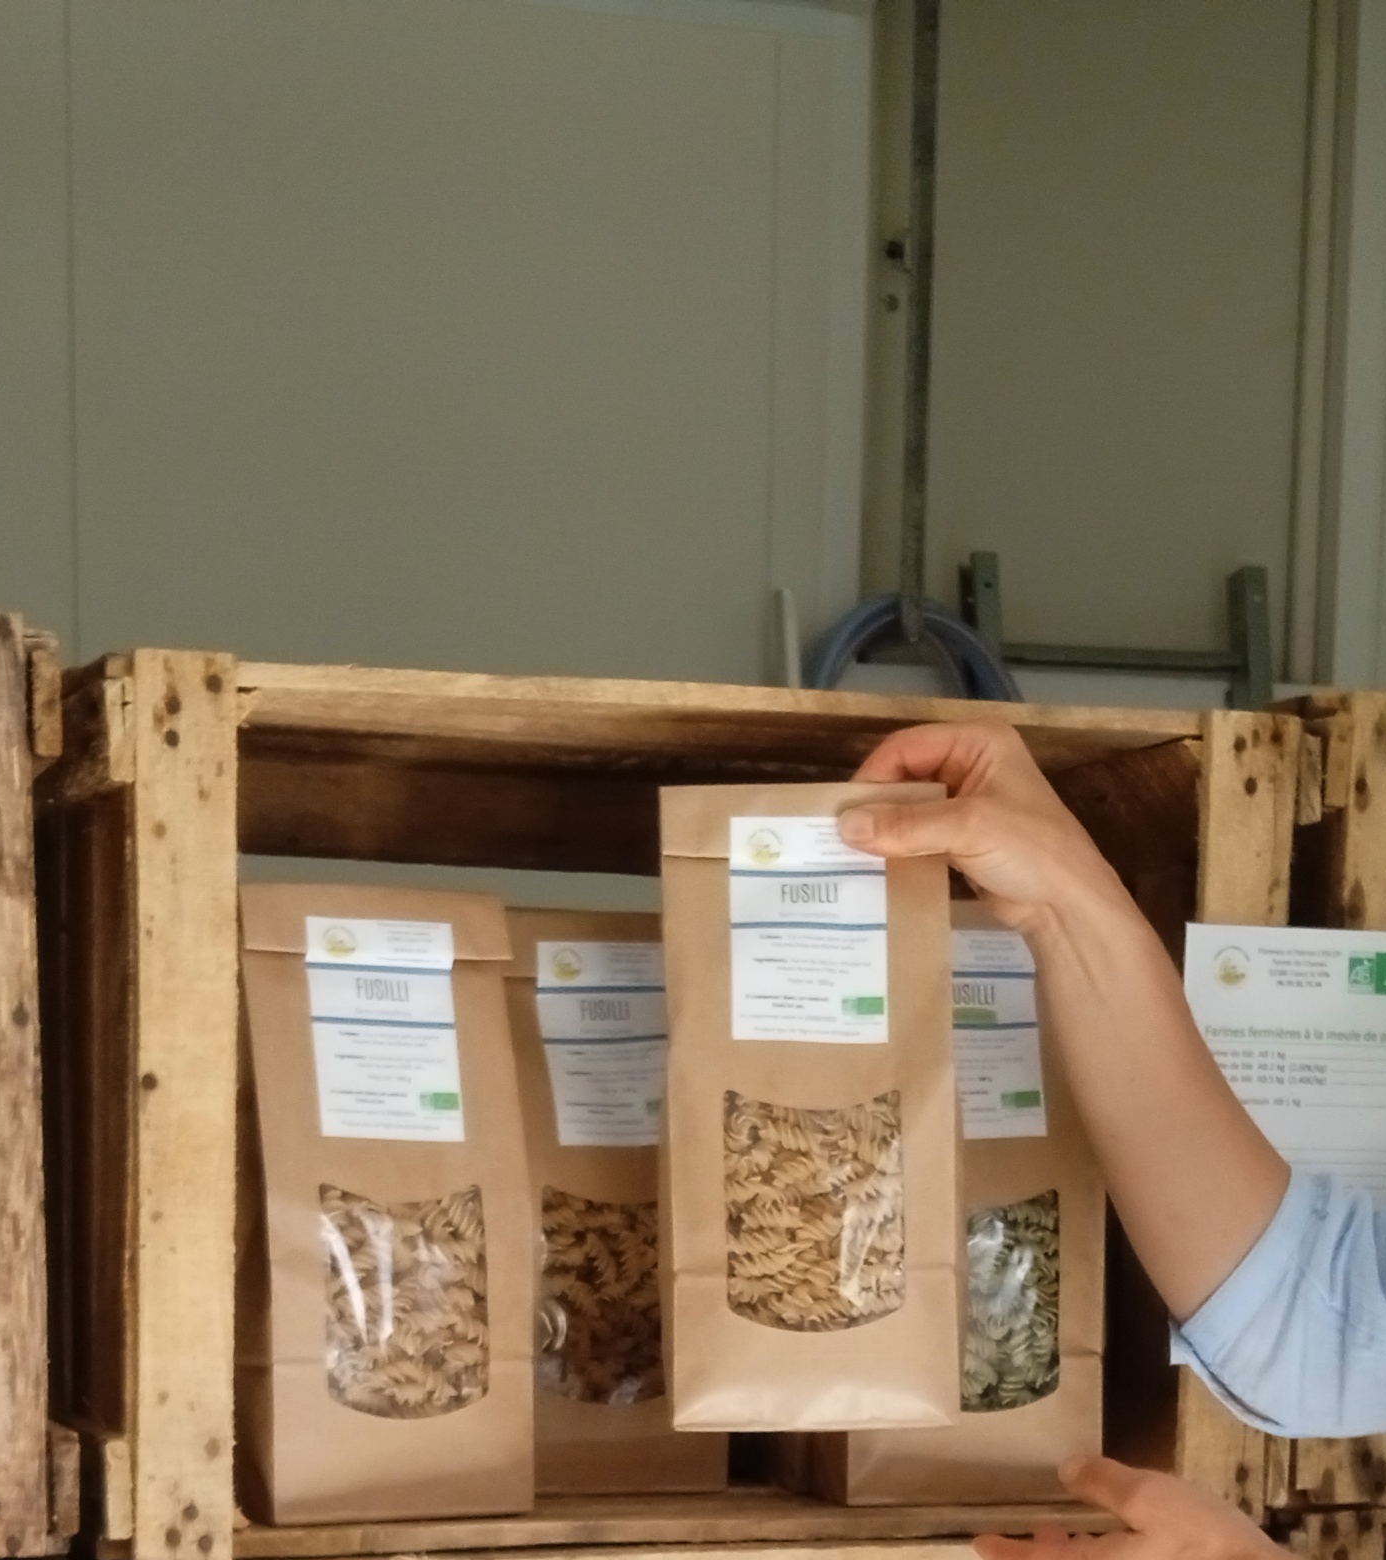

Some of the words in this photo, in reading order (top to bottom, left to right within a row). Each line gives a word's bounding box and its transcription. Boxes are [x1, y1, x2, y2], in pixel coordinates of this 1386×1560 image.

[781, 883, 838, 904] FUSILLI
[355, 978, 410, 1002] FUSILLI
[953, 983, 995, 1005] USILLI
[580, 1000, 631, 1021] FUSILLI
